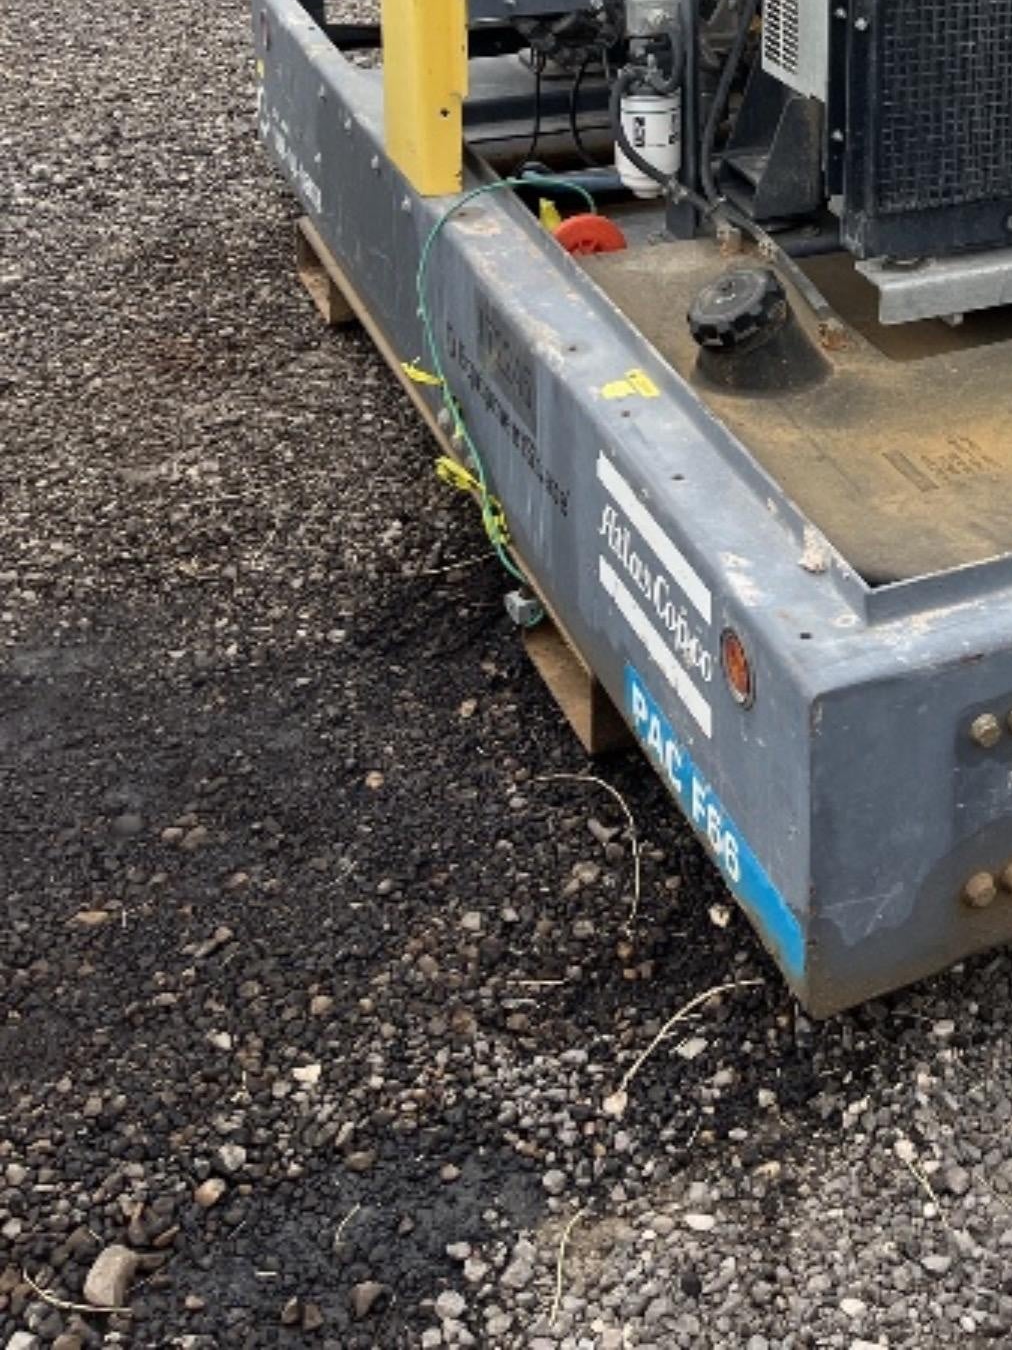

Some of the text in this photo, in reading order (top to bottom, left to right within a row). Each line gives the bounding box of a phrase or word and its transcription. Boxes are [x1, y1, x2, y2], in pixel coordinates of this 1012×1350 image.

[598, 504, 652, 600] Atlas
[631, 680, 741, 883] PAC F66
